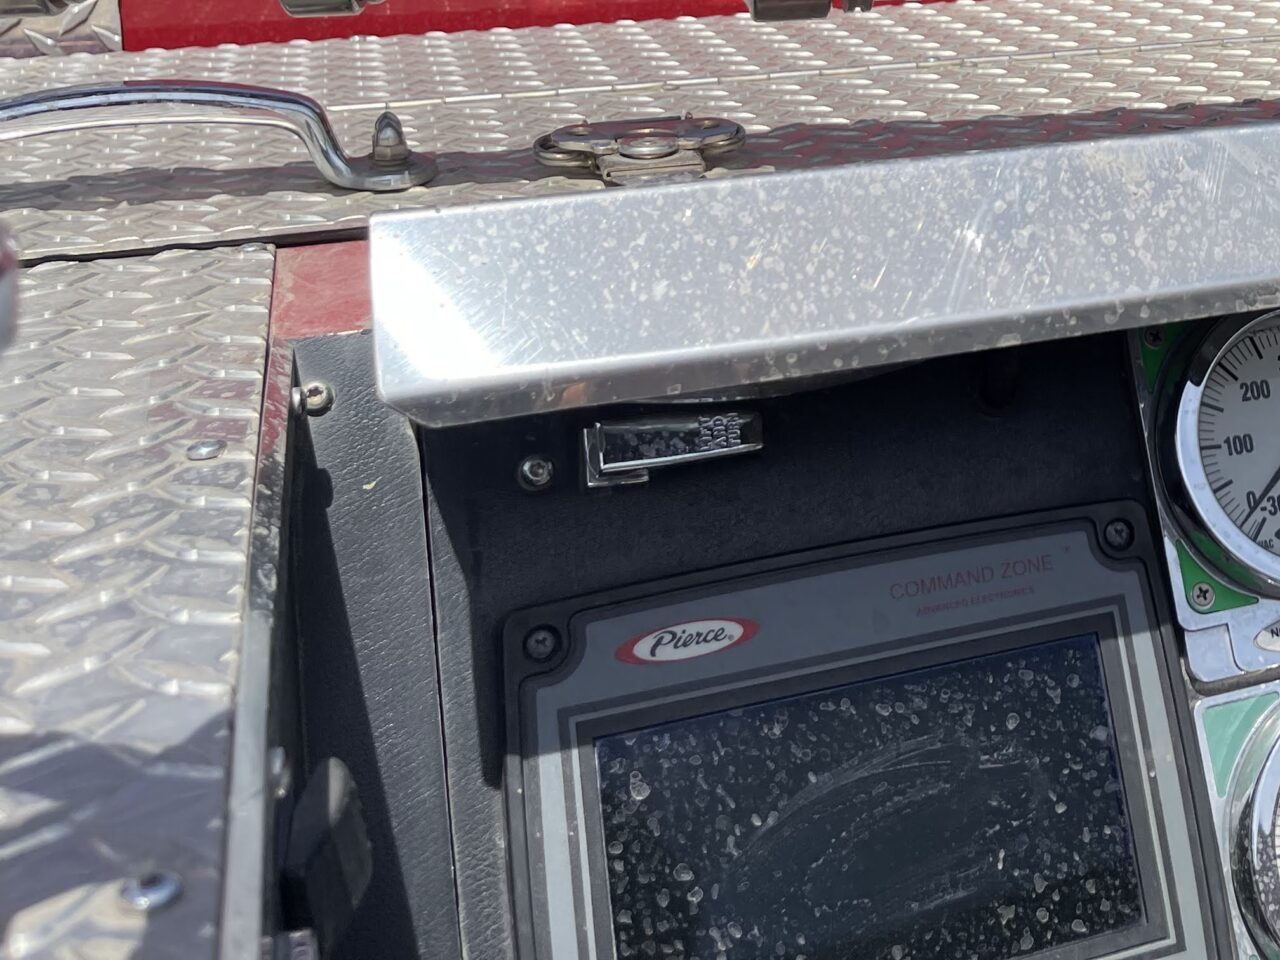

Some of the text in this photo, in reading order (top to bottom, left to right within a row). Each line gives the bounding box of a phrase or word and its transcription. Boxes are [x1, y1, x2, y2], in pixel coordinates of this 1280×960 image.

[1239, 379, 1271, 402] 200
[1224, 433, 1254, 456] 100
[1247, 490, 1258, 511] 0
[890, 554, 1054, 600] COMMAND ZONE
[650, 627, 728, 657] Pierce
